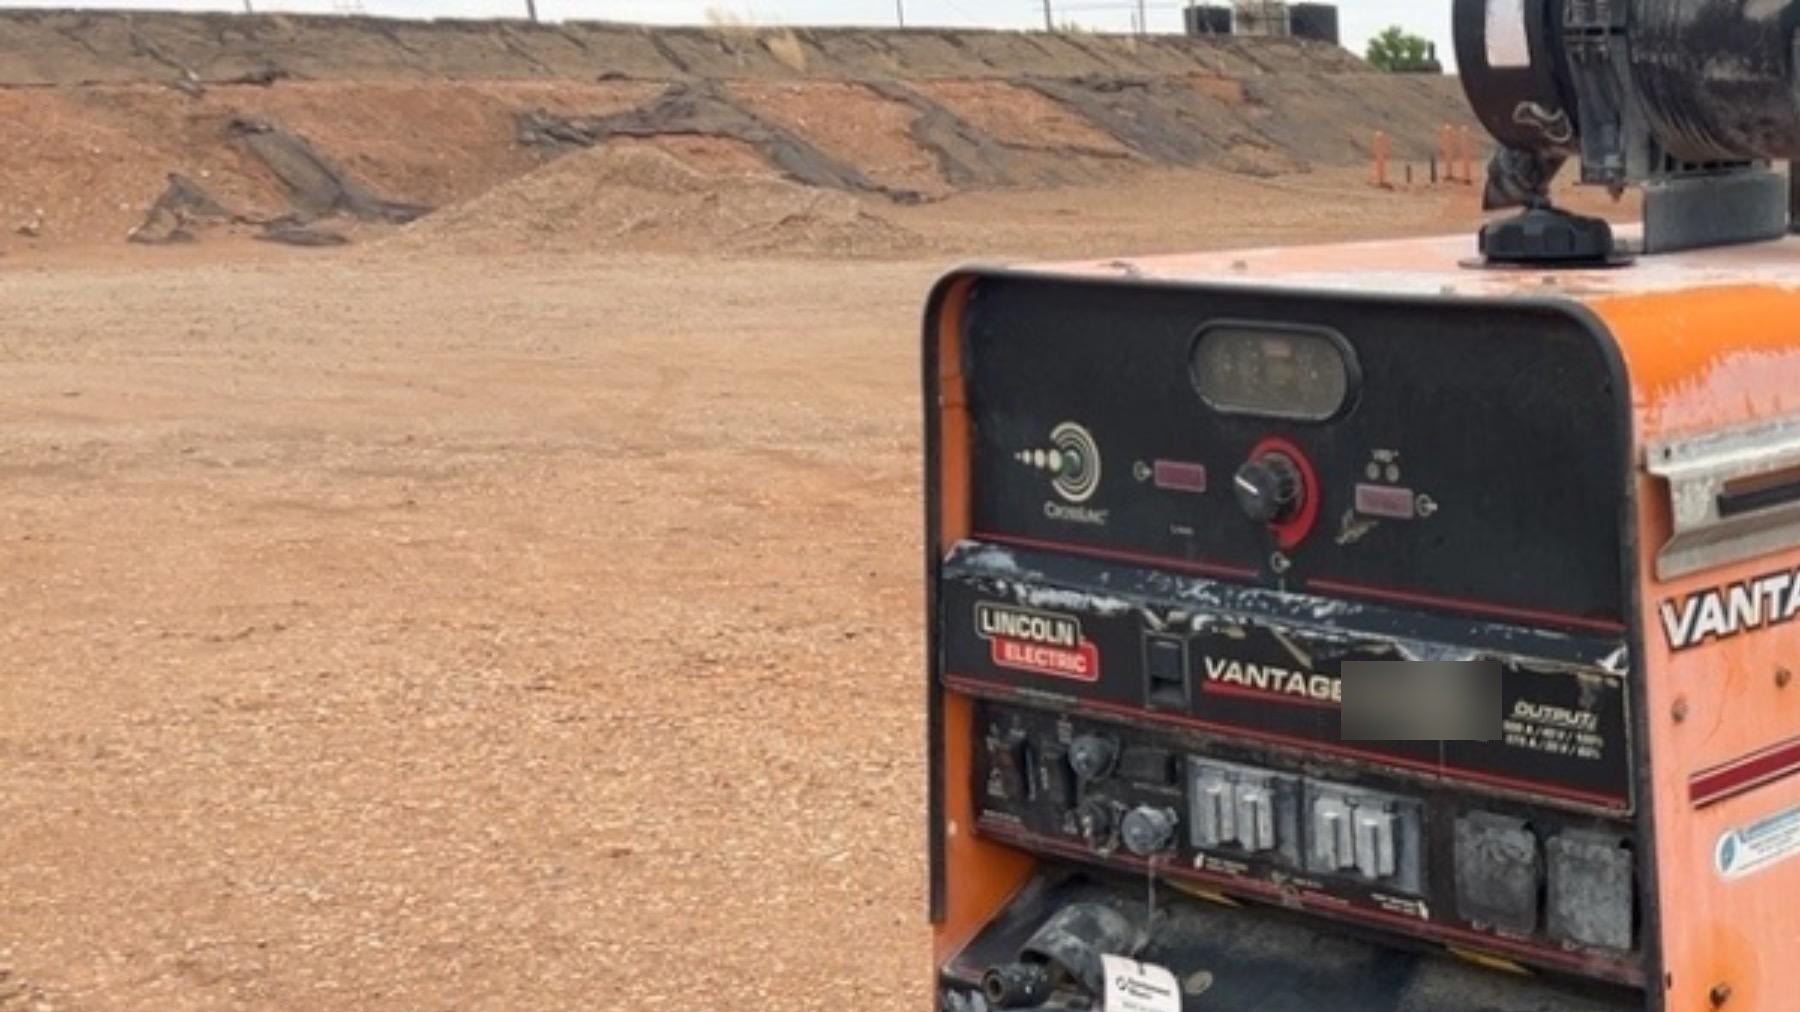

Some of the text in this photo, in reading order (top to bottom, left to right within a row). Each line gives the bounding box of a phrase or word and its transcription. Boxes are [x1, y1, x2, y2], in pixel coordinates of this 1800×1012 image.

[979, 607, 1074, 646] LINCOLN
[1003, 642, 1088, 673] ELECTRIC
[1203, 656, 1342, 702] VANTAGE
